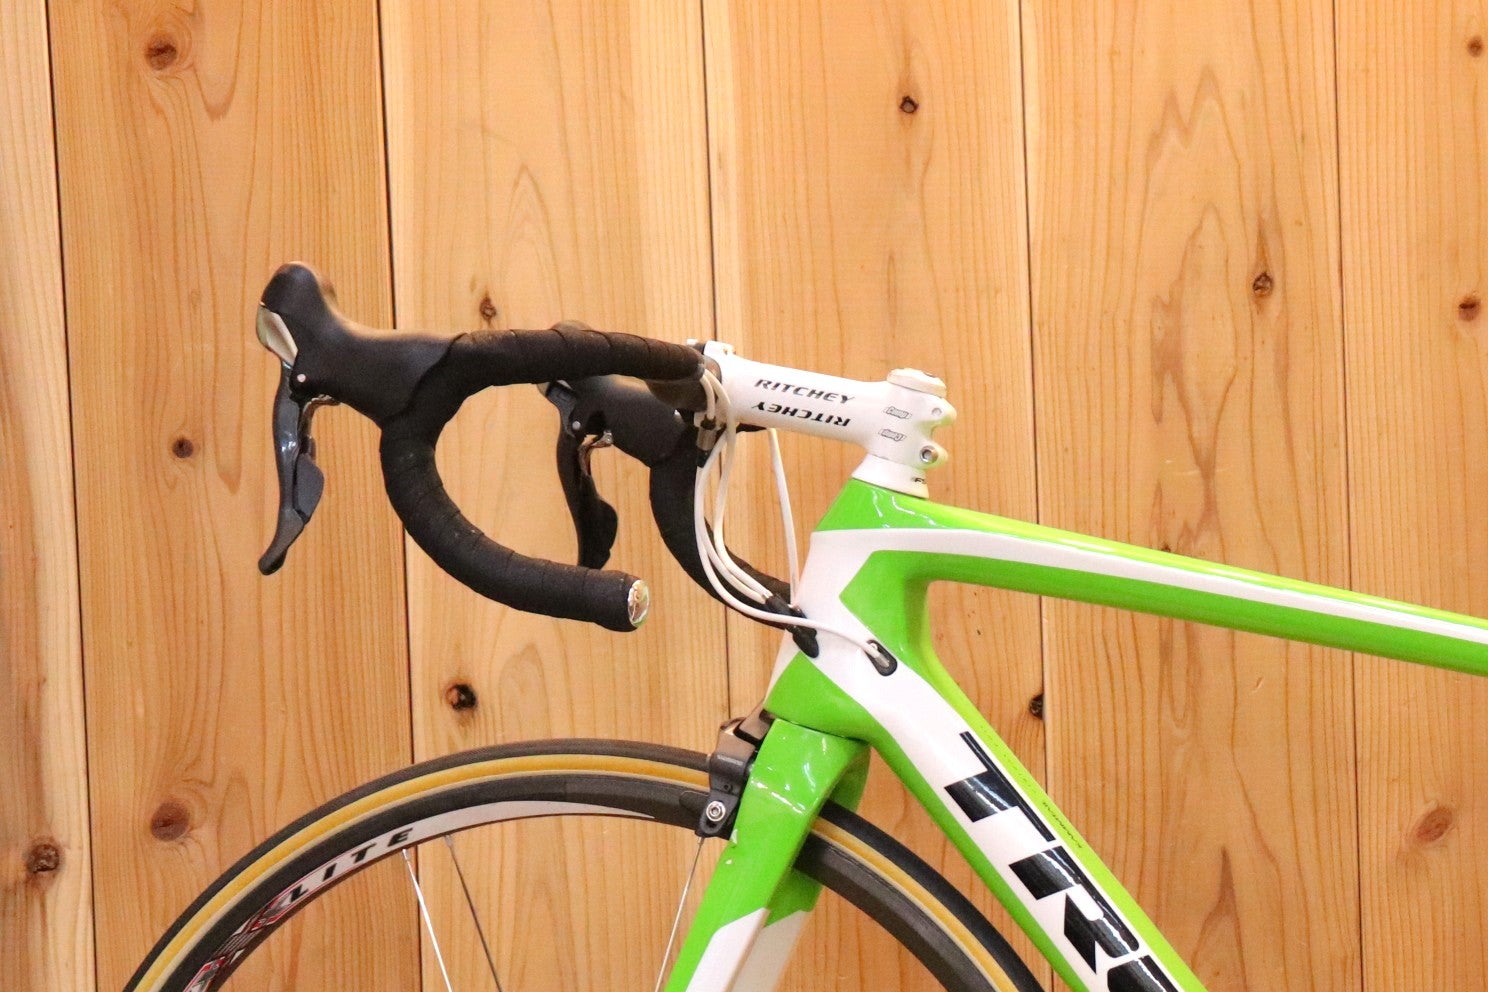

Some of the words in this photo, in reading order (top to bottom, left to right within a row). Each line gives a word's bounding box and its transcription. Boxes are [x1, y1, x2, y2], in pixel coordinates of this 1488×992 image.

[754, 378, 855, 404] RITCHEY
[751, 401, 851, 427] RITCHEY
[288, 828, 412, 903] LITE
